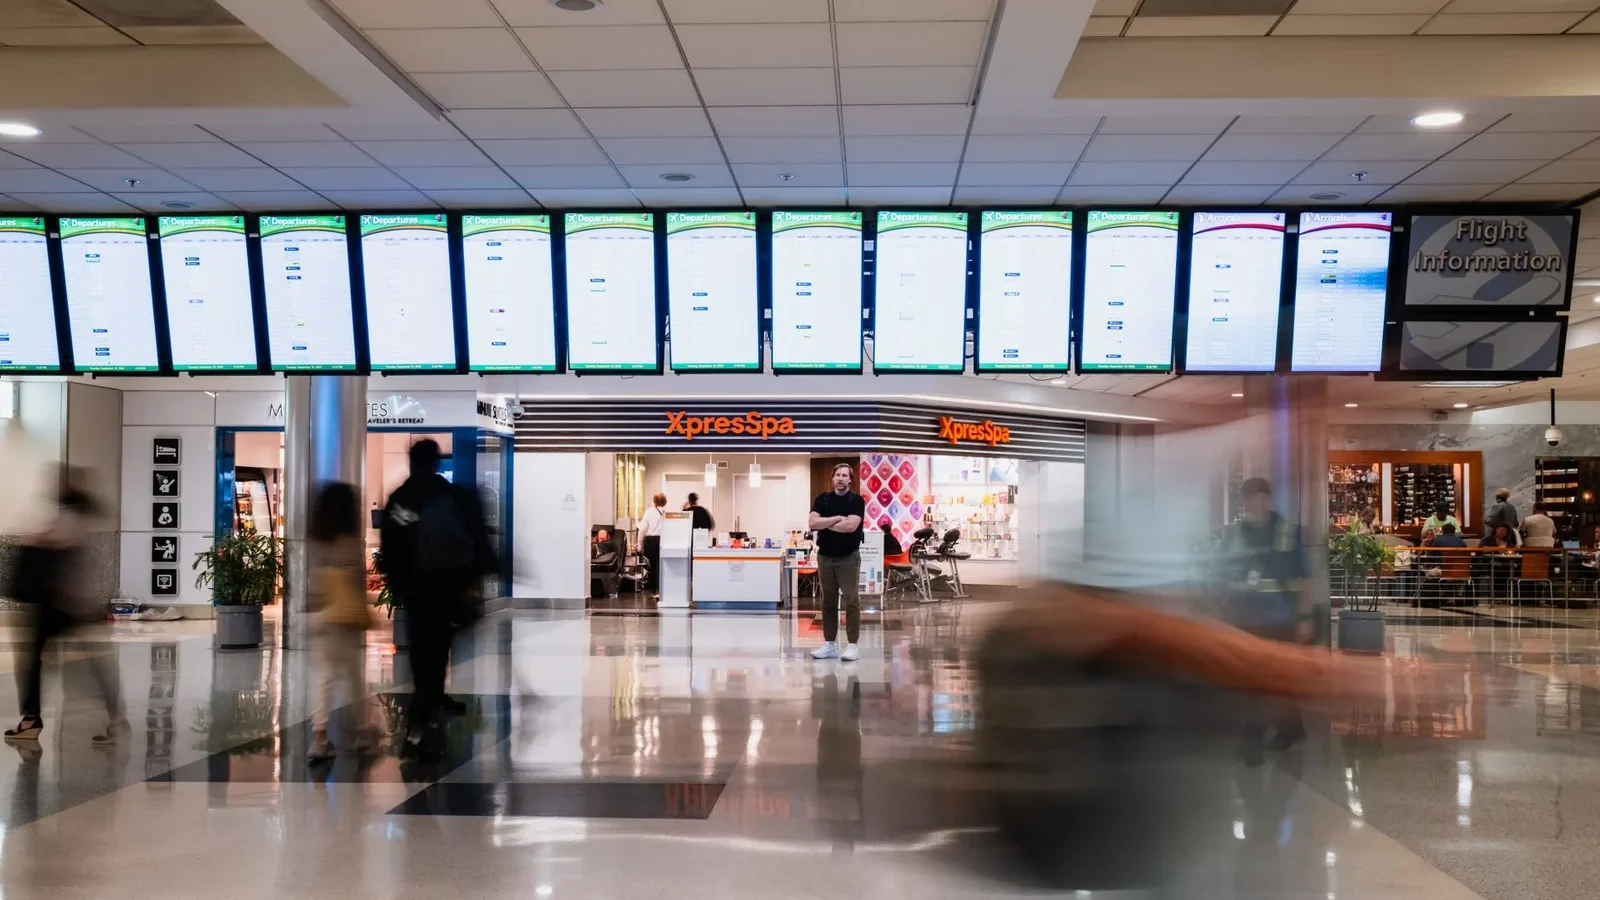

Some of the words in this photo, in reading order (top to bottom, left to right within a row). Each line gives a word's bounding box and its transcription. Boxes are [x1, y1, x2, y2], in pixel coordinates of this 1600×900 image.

[372, 217, 419, 226] Departures
[474, 217, 521, 226] Departures
[577, 215, 625, 224] Departures
[679, 214, 727, 223] Departures
[785, 213, 833, 222] Departures
[891, 213, 938, 222] Departures
[995, 213, 1043, 222] Departures
[1101, 213, 1149, 222] Departures
[1207, 213, 1241, 222] Arrivals
[1313, 213, 1348, 222] Arrivals
[71, 219, 117, 228] Departures
[171, 218, 216, 227] Departures
[271, 218, 317, 227] Departures
[1455, 219, 1528, 246] Flight
[1414, 250, 1562, 271] Information
[665, 411, 795, 440] XpresSpa
[939, 416, 1011, 447] XpresSpa
